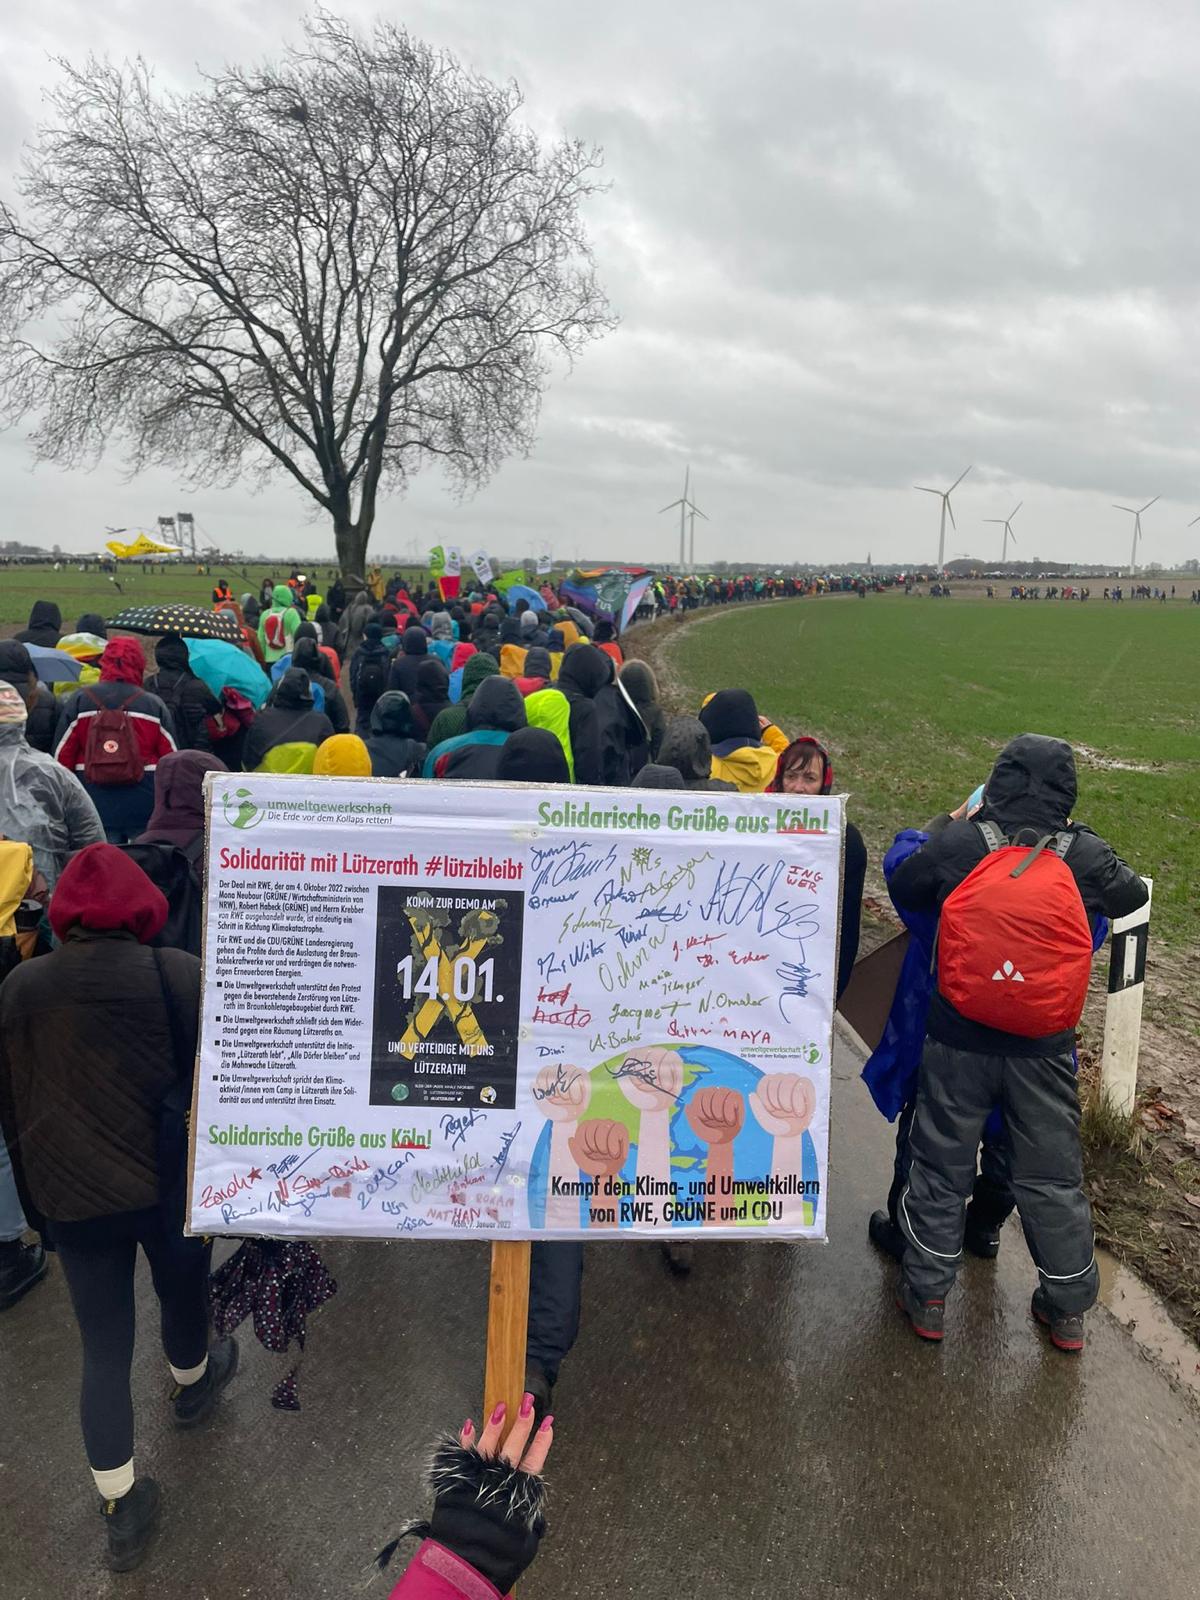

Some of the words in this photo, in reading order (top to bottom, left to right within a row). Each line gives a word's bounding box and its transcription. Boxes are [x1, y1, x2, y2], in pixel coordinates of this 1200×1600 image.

[268, 800, 392, 814] umweltgewerkschaft
[268, 812, 280, 820] Die
[283, 812, 300, 821] Erde
[317, 814, 334, 823] dem
[336, 815, 364, 825] Kollaps
[366, 816, 392, 824] retten!
[538, 801, 661, 830] Solidarische
[667, 805, 729, 833] Grüße
[735, 815, 770, 834] aus
[776, 808, 829, 832] Köln!
[220, 847, 305, 871] Solidarität
[311, 853, 338, 873] mit
[343, 852, 418, 876] Lützerath
[425, 855, 523, 880] #lützibleibt
[219, 880, 230, 888] Der
[231, 880, 245, 889] Deal
[274, 882, 284, 890] der
[303, 883, 327, 892] Oktober
[328, 883, 343, 892] 2022
[344, 884, 369, 893] zwischen
[219, 890, 235, 899] Mona
[236, 891, 262, 900] Neubaur
[238, 901, 258, 910] Robert
[259, 902, 281, 911] Habeck
[310, 904, 321, 912] und
[323, 904, 340, 913] Herrn
[341, 905, 364, 914] Krebber
[406, 896, 434, 908] KOMM
[436, 897, 453, 909] ZUR
[455, 898, 480, 910] DEMO
[481, 899, 496, 910] AM
[217, 921, 236, 930] Schritt
[245, 922, 270, 933] Richtung
[217, 935, 228, 943] Für
[228, 935, 242, 944] RWE
[243, 936, 255, 944] und
[256, 936, 266, 945] die
[305, 938, 353, 949] Landesregierung
[216, 945, 235, 955] gehen
[236, 946, 245, 955] die
[247, 946, 267, 955] Profite
[268, 946, 284, 956] durch
[285, 947, 295, 956] die
[296, 948, 327, 958] Auslastung
[328, 948, 339, 957] der
[216, 956, 263, 966] kohlekraftwerke
[275, 958, 287, 966] und
[288, 958, 321, 969] verdrängen
[322, 959, 332, 968] die
[215, 966, 232, 977] digen
[233, 967, 274, 976] Erneuerbaren
[397, 955, 504, 1003] 14.01.
[224, 980, 234, 989] Die
[235, 981, 296, 991] Umweltgewerkschaft
[297, 984, 327, 992] unterstützt
[328, 984, 340, 992] den
[341, 984, 361, 992] Protest
[223, 993, 242, 1002] gegen
[243, 991, 253, 1000] die
[254, 991, 296, 1001] bevorstehende
[297, 992, 328, 1004] Zerstörung
[223, 1001, 236, 1010] rath
[246, 1002, 321, 1013] Braunkohletagebaugebiet
[322, 1002, 339, 1012] durch
[223, 1015, 233, 1024] Die
[234, 1015, 294, 1026] Umweltgewerkschaft
[295, 1016, 317, 1025] schließt
[318, 1017, 329, 1026] sich
[330, 1017, 343, 1026] dem
[222, 1025, 238, 1034] stand
[240, 1026, 258, 1036] gegen
[273, 1026, 302, 1037] Räumung
[303, 1027, 333, 1036] Lützeraths
[723, 1030, 771, 1044] MAYA
[222, 1039, 232, 1048] Die
[233, 1039, 294, 1049] Umweltgewerkschaft
[294, 1041, 325, 1049] unterstützt
[326, 1041, 336, 1050] die
[388, 1041, 406, 1053] UND
[408, 1042, 457, 1055] VERTEIDIGE
[459, 1044, 476, 1056] MIT
[476, 1045, 494, 1056] UNS
[221, 1050, 236, 1058] tiven
[303, 1051, 322, 1060] Dörfer
[349, 1052, 360, 1061] und
[220, 1060, 230, 1069] die
[231, 1060, 266, 1069] Mahnwache
[414, 1061, 467, 1075] LÜTZERATH!
[220, 1074, 231, 1082] Die
[232, 1074, 292, 1084] Umweltgewerkschaft
[293, 1075, 312, 1085] spricht
[313, 1075, 324, 1084] den
[276, 1085, 293, 1095] Camp
[301, 1085, 329, 1095] Lützerath
[330, 1086, 342, 1095] ihre
[219, 1095, 239, 1104] darität
[252, 1095, 264, 1104] und
[265, 1096, 296, 1104] unterstützt
[297, 1096, 313, 1104] ihren
[208, 1125, 303, 1147] Solidarische
[308, 1125, 355, 1148] Grüße
[360, 1133, 386, 1148] aus
[391, 1127, 432, 1149] Köln!
[552, 1175, 600, 1202] Kampf
[604, 1176, 630, 1196] den
[636, 1175, 684, 1195] Klima-
[689, 1176, 715, 1195] und
[720, 1175, 820, 1196] Umweltkillern
[589, 1208, 615, 1223] von
[620, 1203, 658, 1226] RWE,
[663, 1200, 716, 1222] GRÜNE
[721, 1202, 747, 1221] und
[752, 1201, 783, 1220] CDU
